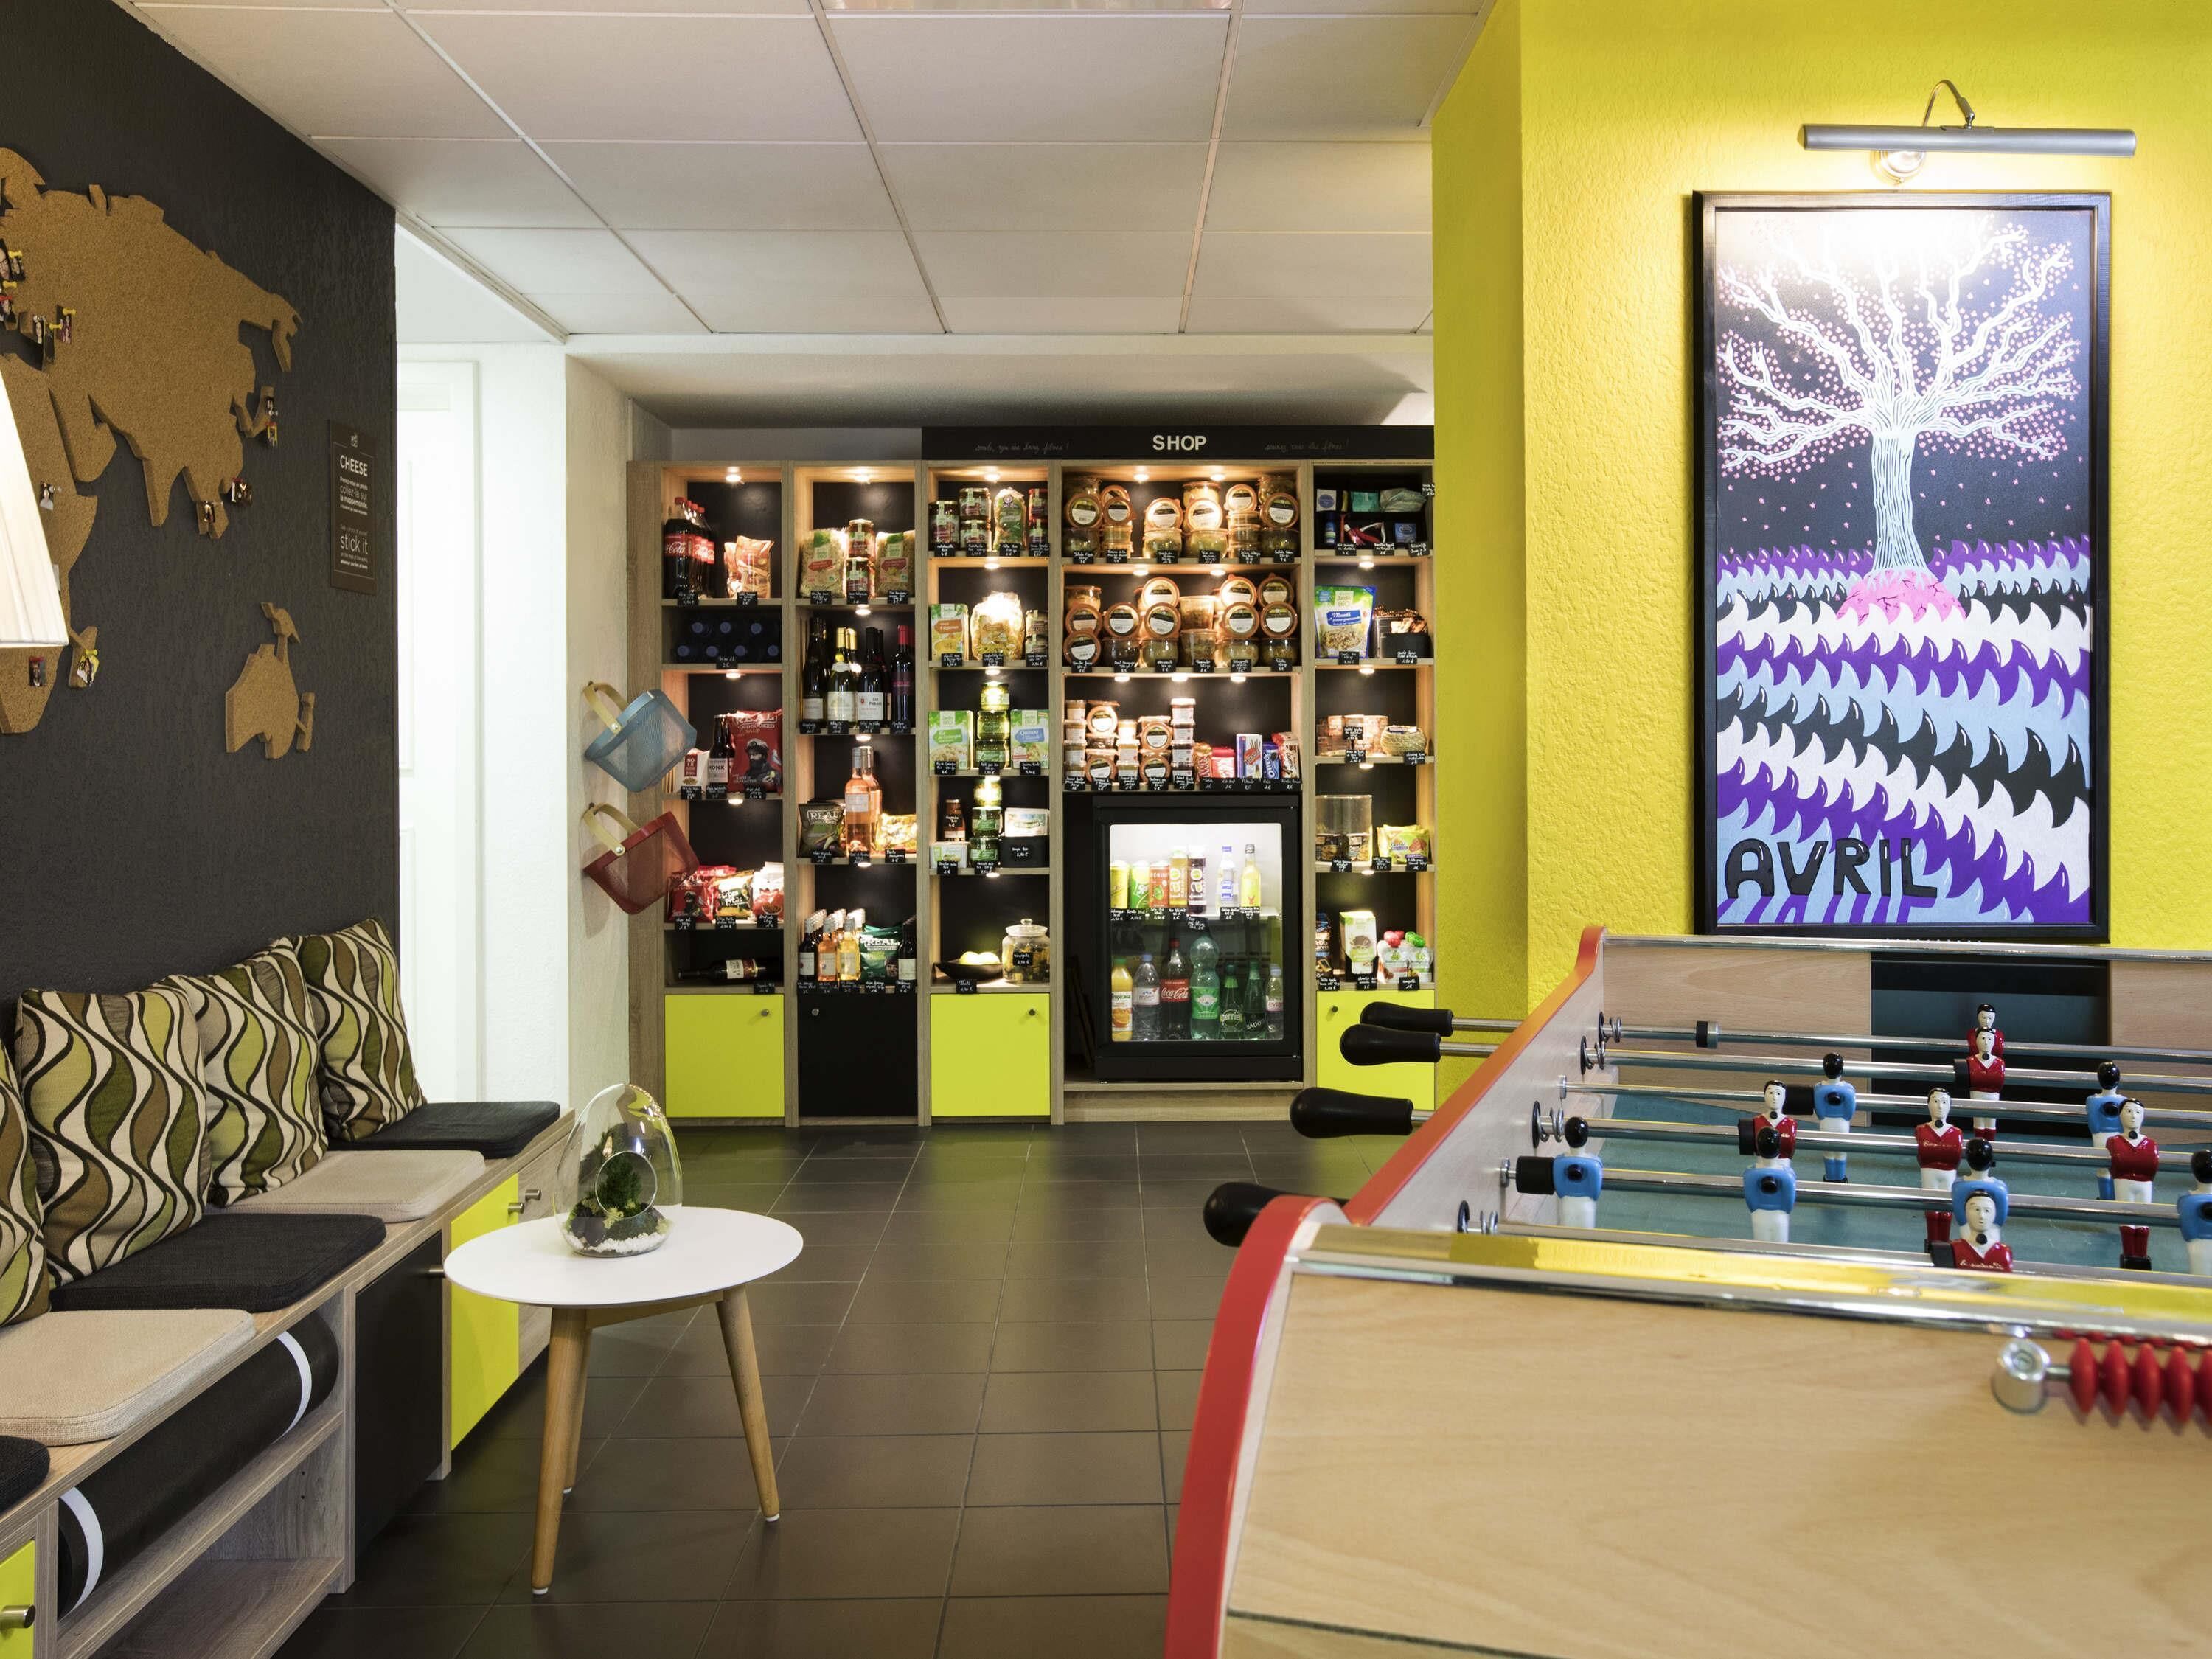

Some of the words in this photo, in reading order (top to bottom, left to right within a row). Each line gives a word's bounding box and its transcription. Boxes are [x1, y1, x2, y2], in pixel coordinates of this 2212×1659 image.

[1152, 435, 1206, 451] SHOP
[340, 454, 368, 477] CHEESE
[340, 533, 361, 553] stick
[363, 538, 369, 554] it
[810, 812, 839, 821] REAL
[1725, 838, 1938, 899] AVRIL
[1189, 869, 1203, 899] tao
[866, 938, 897, 946] REAL
